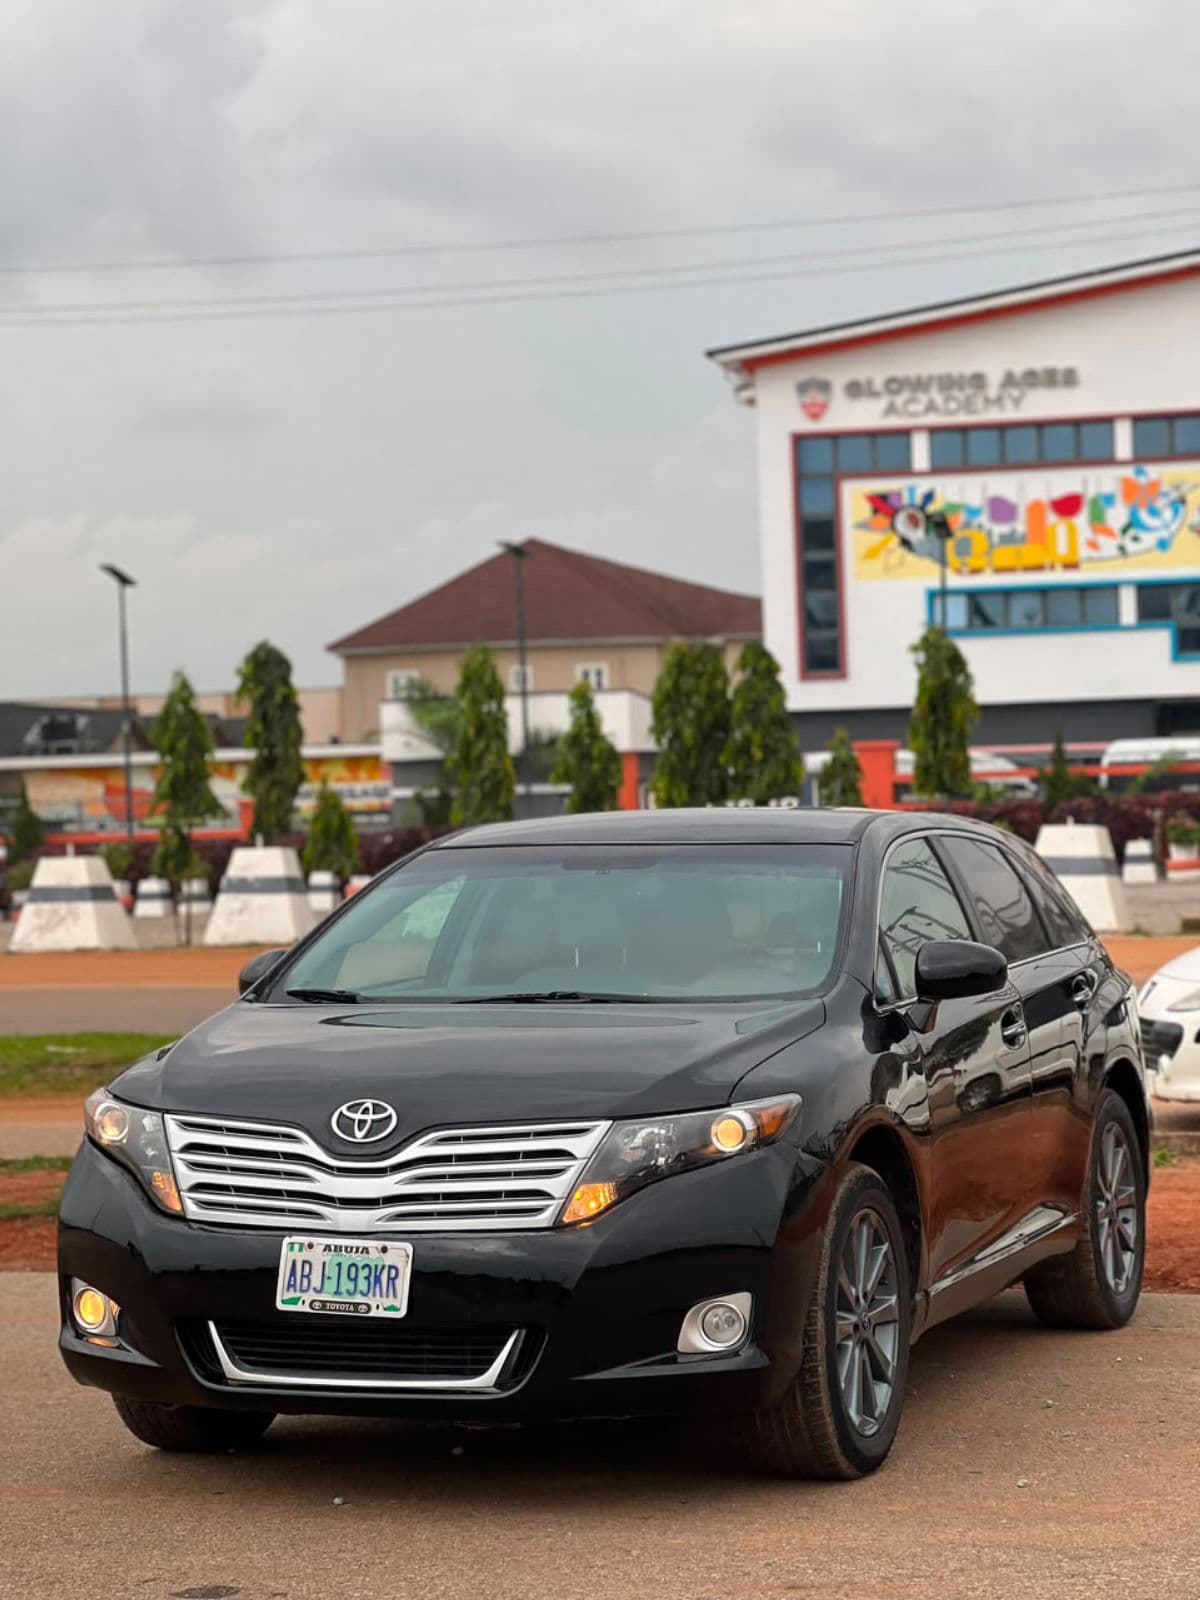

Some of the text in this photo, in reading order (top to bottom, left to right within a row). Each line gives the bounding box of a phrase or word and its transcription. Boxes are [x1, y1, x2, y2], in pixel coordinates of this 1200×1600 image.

[845, 367, 1079, 398] GLOWING AGES
[883, 389, 1025, 417] ACADEMY
[322, 1244, 370, 1255] ABUJA
[287, 1259, 399, 1298] ABJ-193KR
[325, 1303, 355, 1311] TOYOTA
